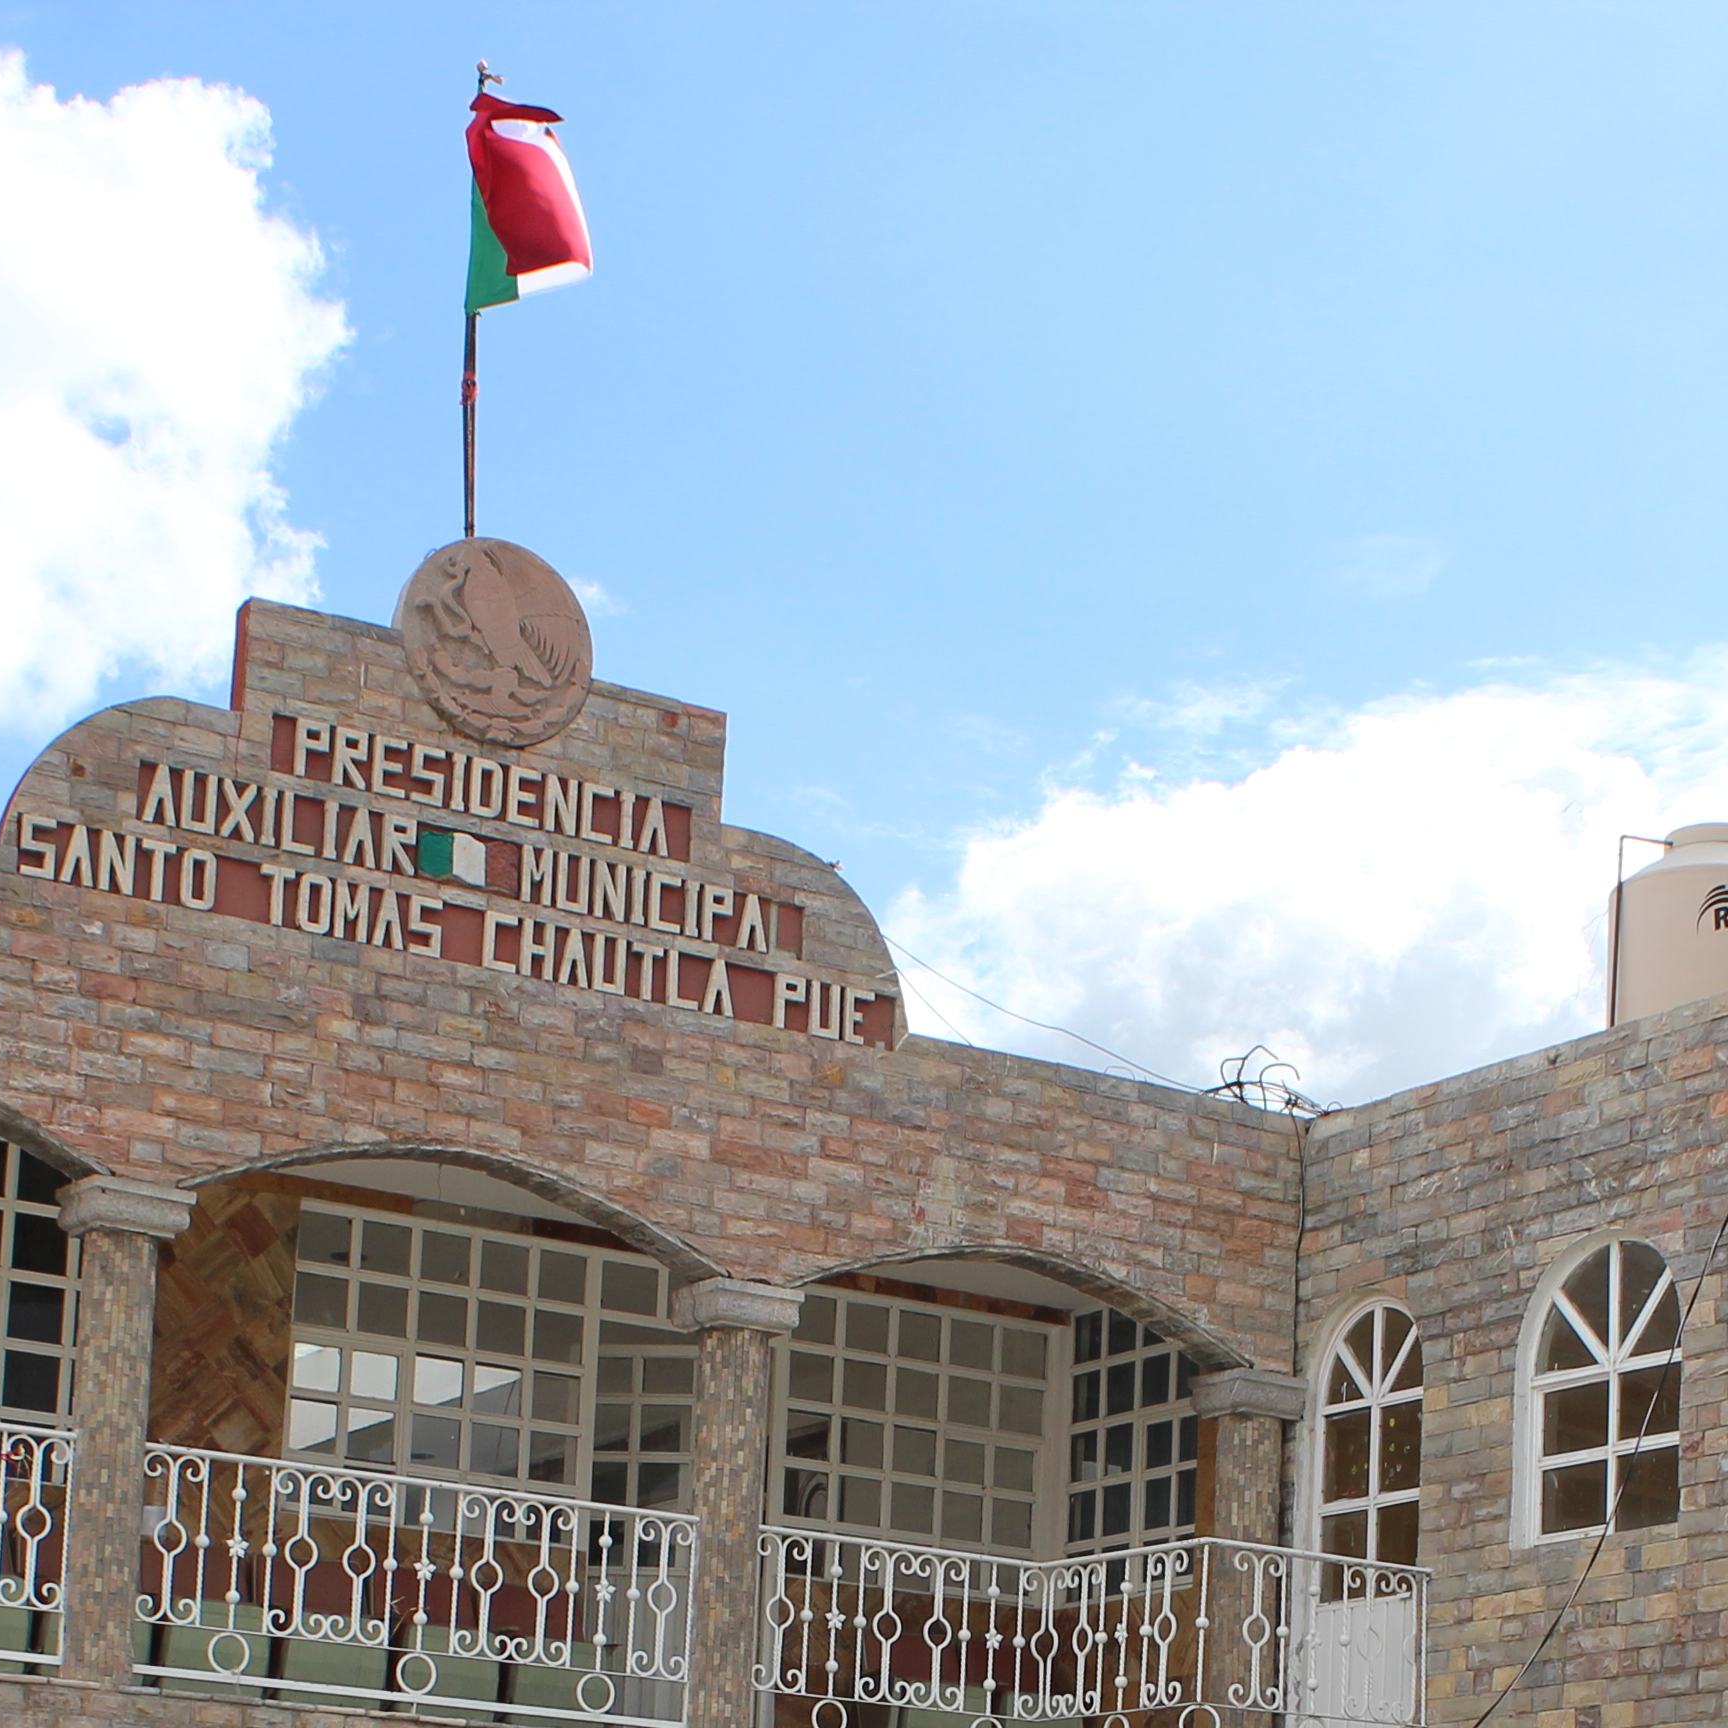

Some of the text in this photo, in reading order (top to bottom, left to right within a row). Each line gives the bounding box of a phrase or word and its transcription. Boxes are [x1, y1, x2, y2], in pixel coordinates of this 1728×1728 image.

[141, 763, 418, 877] AUXILIAR
[293, 716, 669, 858] PRESIDENCIA
[18, 812, 218, 911] SANTO
[260, 863, 444, 959] TOMAS
[481, 909, 734, 1018] CHAUTLA
